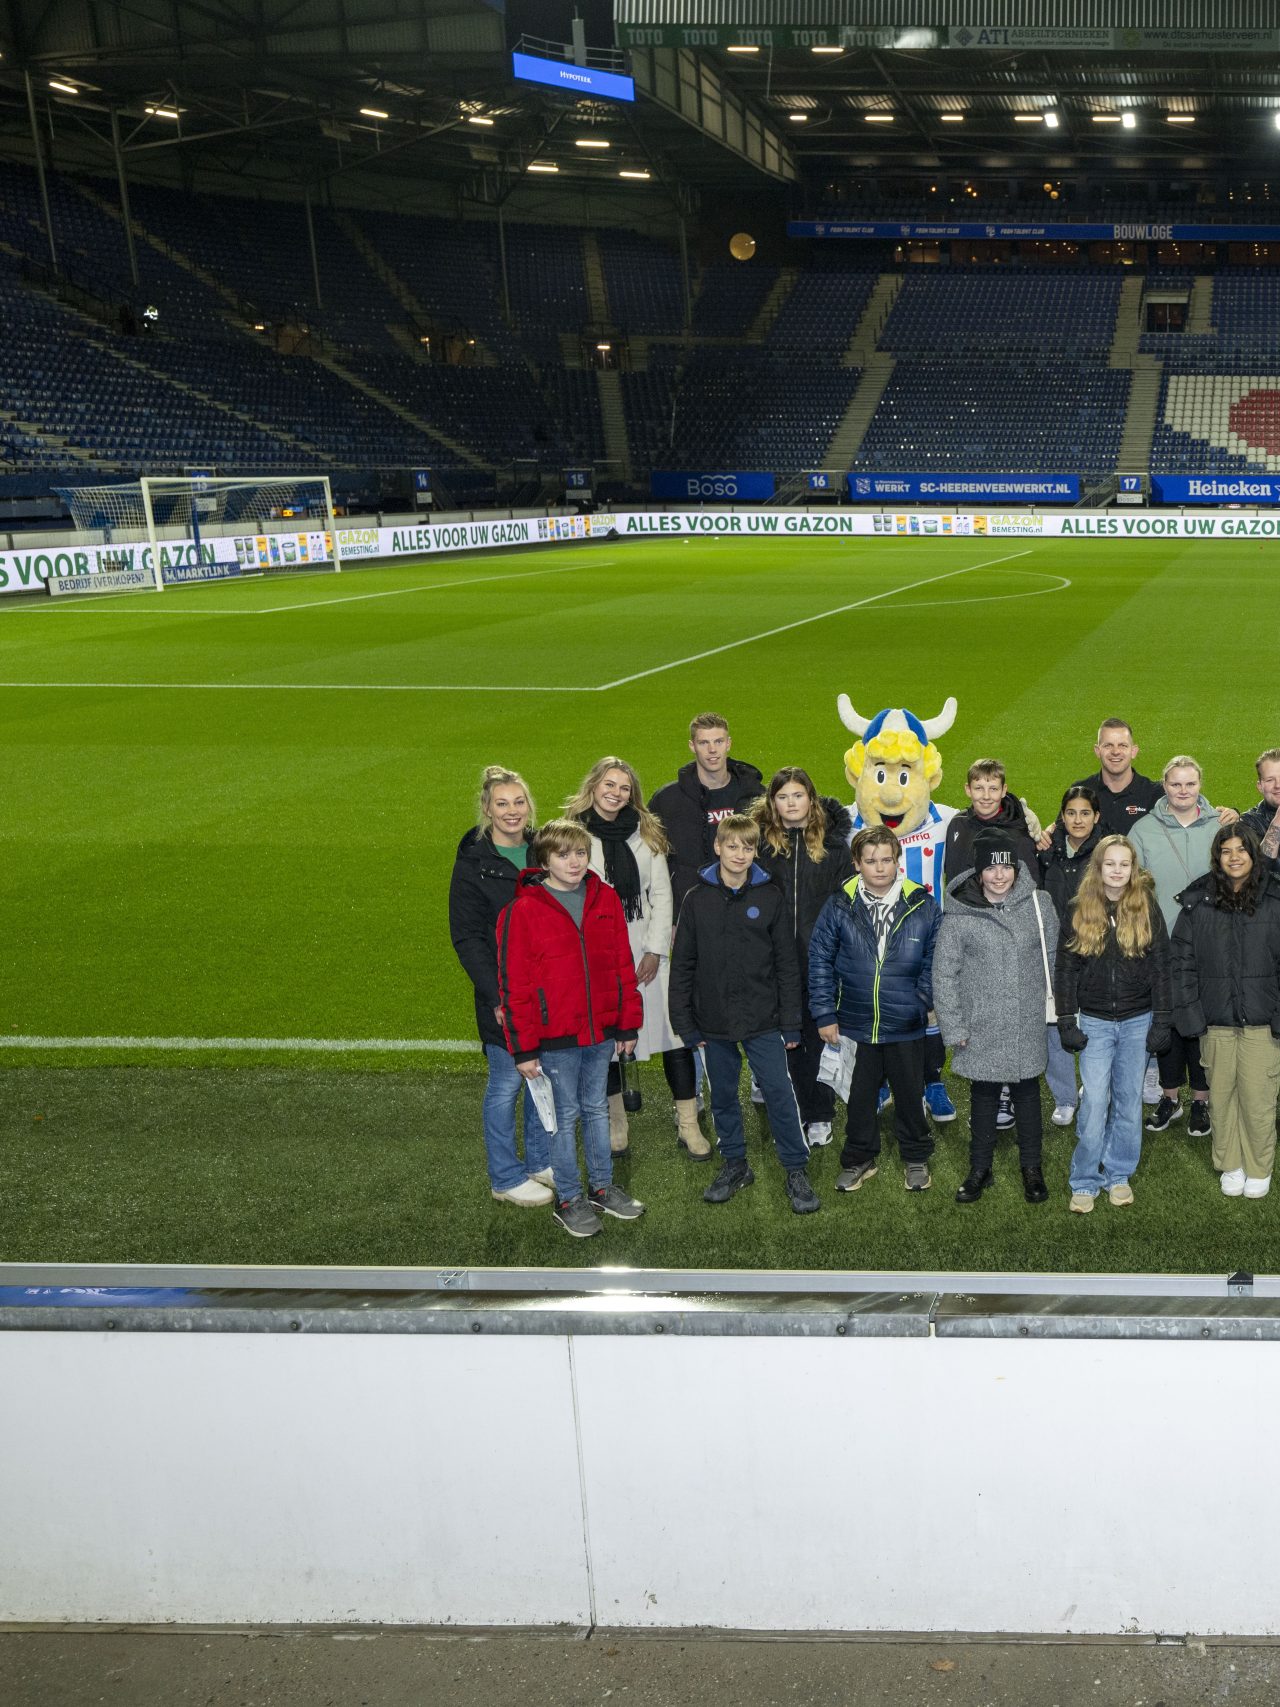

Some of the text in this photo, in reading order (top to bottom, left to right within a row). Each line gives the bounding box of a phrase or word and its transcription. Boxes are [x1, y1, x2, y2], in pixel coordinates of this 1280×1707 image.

[627, 29, 663, 45] TOTO
[682, 29, 718, 45] TOTO
[737, 30, 772, 46] TOTO
[792, 30, 827, 46] TOTO
[977, 29, 1009, 45] ATI
[1113, 225, 1173, 240] BOUWLOGE
[418, 474, 428, 488] 14
[571, 474, 584, 486] 15
[812, 475, 826, 487] 16
[1124, 478, 1137, 490] 17
[875, 483, 910, 493] WERKT
[920, 483, 1071, 494] SC-HEERENVEENWERKT.NL
[1188, 480, 1272, 496] Heineken
[591, 515, 616, 526] GAZON
[627, 516, 853, 532] ALLES VOOR UW GAZON
[990, 516, 1043, 526] GAZON
[1061, 519, 1118, 534] ALLES
[1123, 519, 1178, 534] VOOR
[1184, 520, 1215, 535] UW
[339, 529, 379, 545] GAZON
[392, 522, 529, 552] ALLES VOOR UW GAZON
[340, 545, 380, 556] BEMESTING.nl
[13, 552, 89, 585] VOOR
[177, 566, 229, 580] MARKTLINK
[59, 573, 145, 592] BEDRIJF (VER)KOPEN?
[707, 809, 735, 823] evi
[899, 833, 930, 845] nutria
